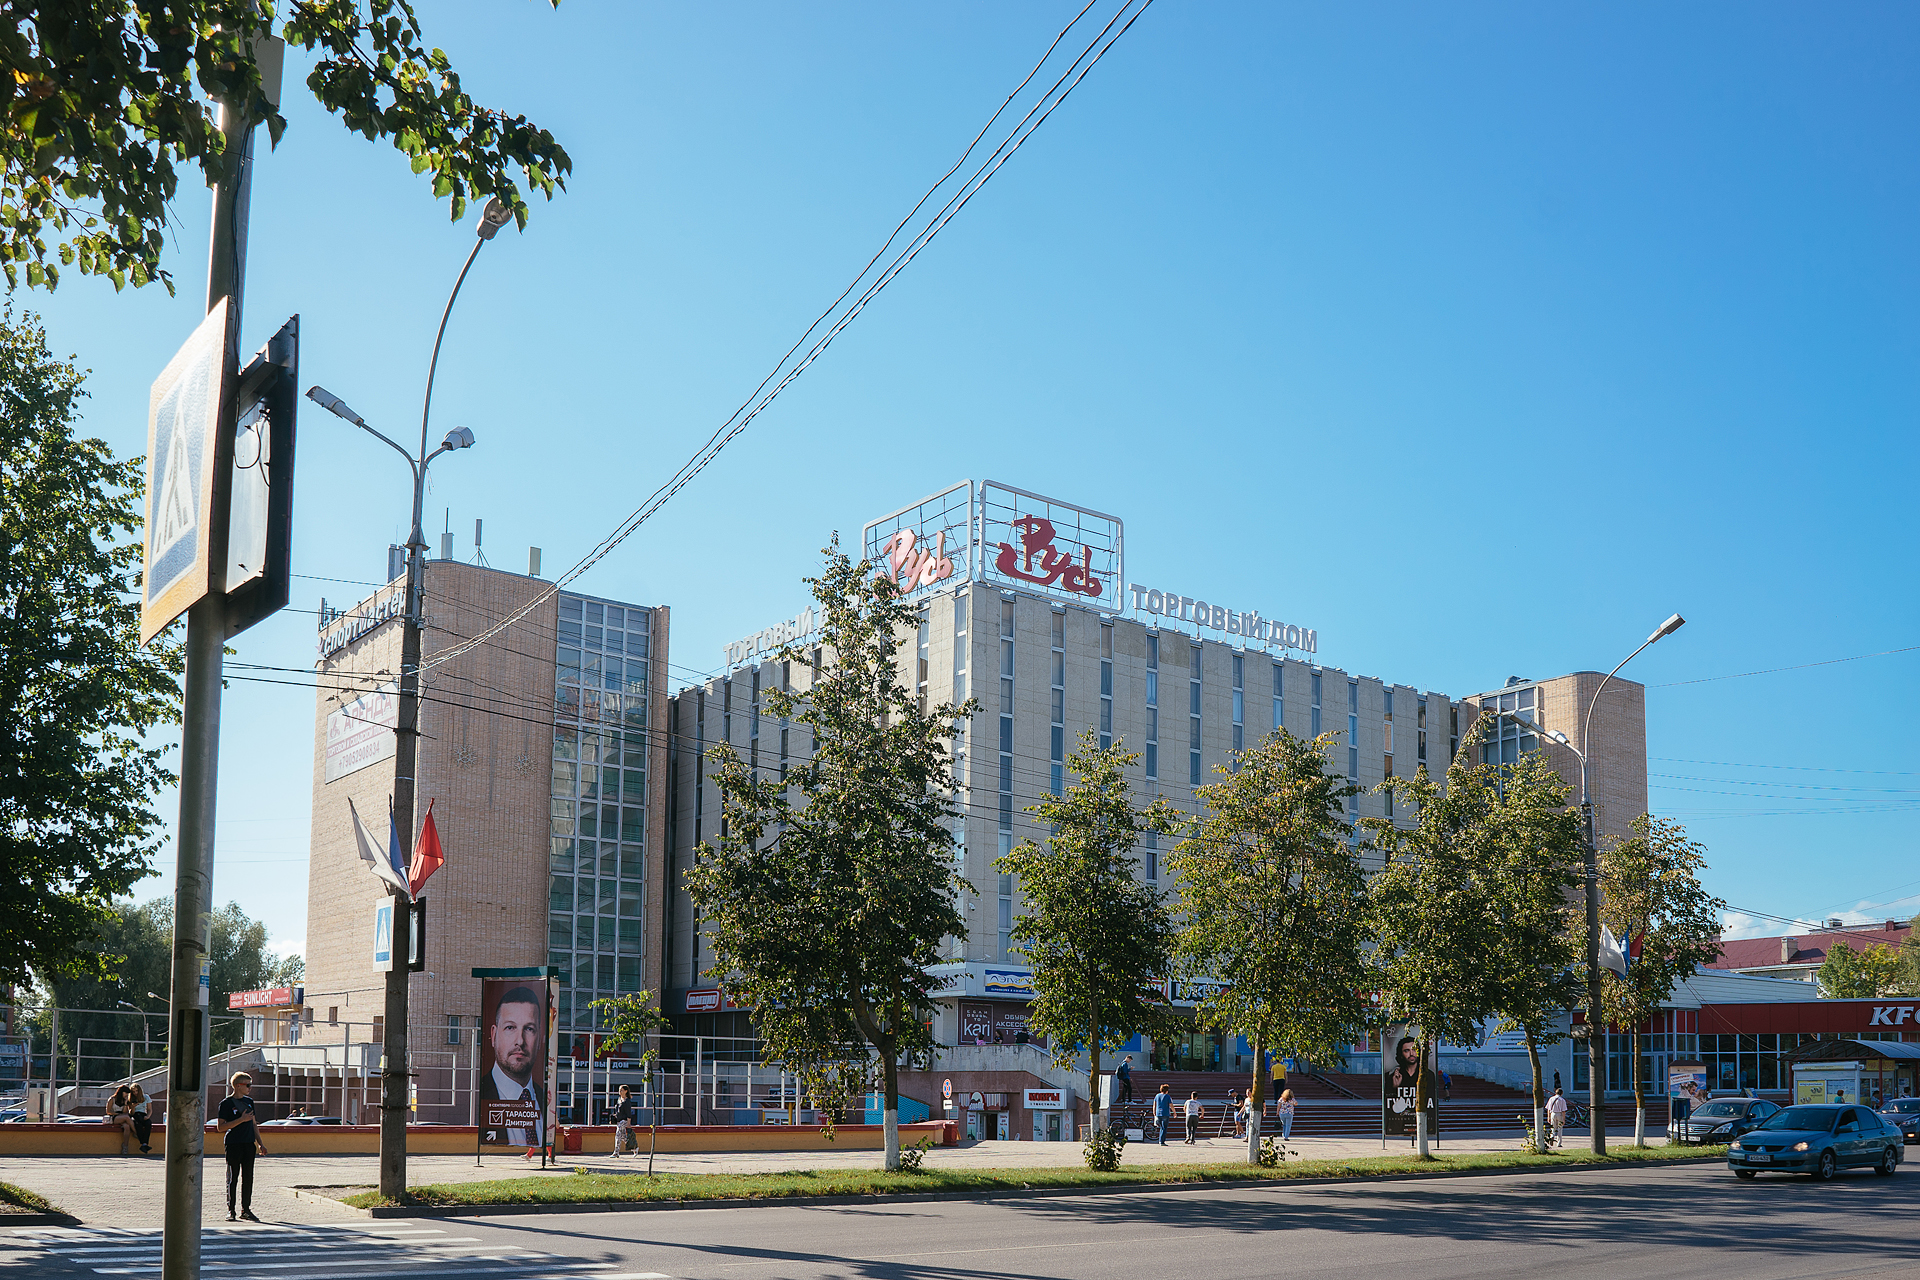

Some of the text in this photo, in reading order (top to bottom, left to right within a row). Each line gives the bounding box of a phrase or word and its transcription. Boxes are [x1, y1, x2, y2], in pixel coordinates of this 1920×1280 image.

[876, 528, 954, 599] Русь
[996, 514, 1102, 597] Русь
[1128, 582, 1319, 654] ТОРГОВЫЙ ДОМ
[723, 605, 815, 667] ТОРГОВЫЙ
[343, 694, 393, 732] АРЕНДА
[244, 991, 272, 1005] SUNLIGHT
[963, 1018, 991, 1037] kari
[1013, 1029, 1035, 1037] ЭТЖ
[611, 1061, 629, 1069] ДОМ
[1028, 1092, 1060, 1101] КОВРЫ
[505, 1110, 539, 1118] ТАРАСОВА
[504, 1119, 534, 1128] Дмитрия
